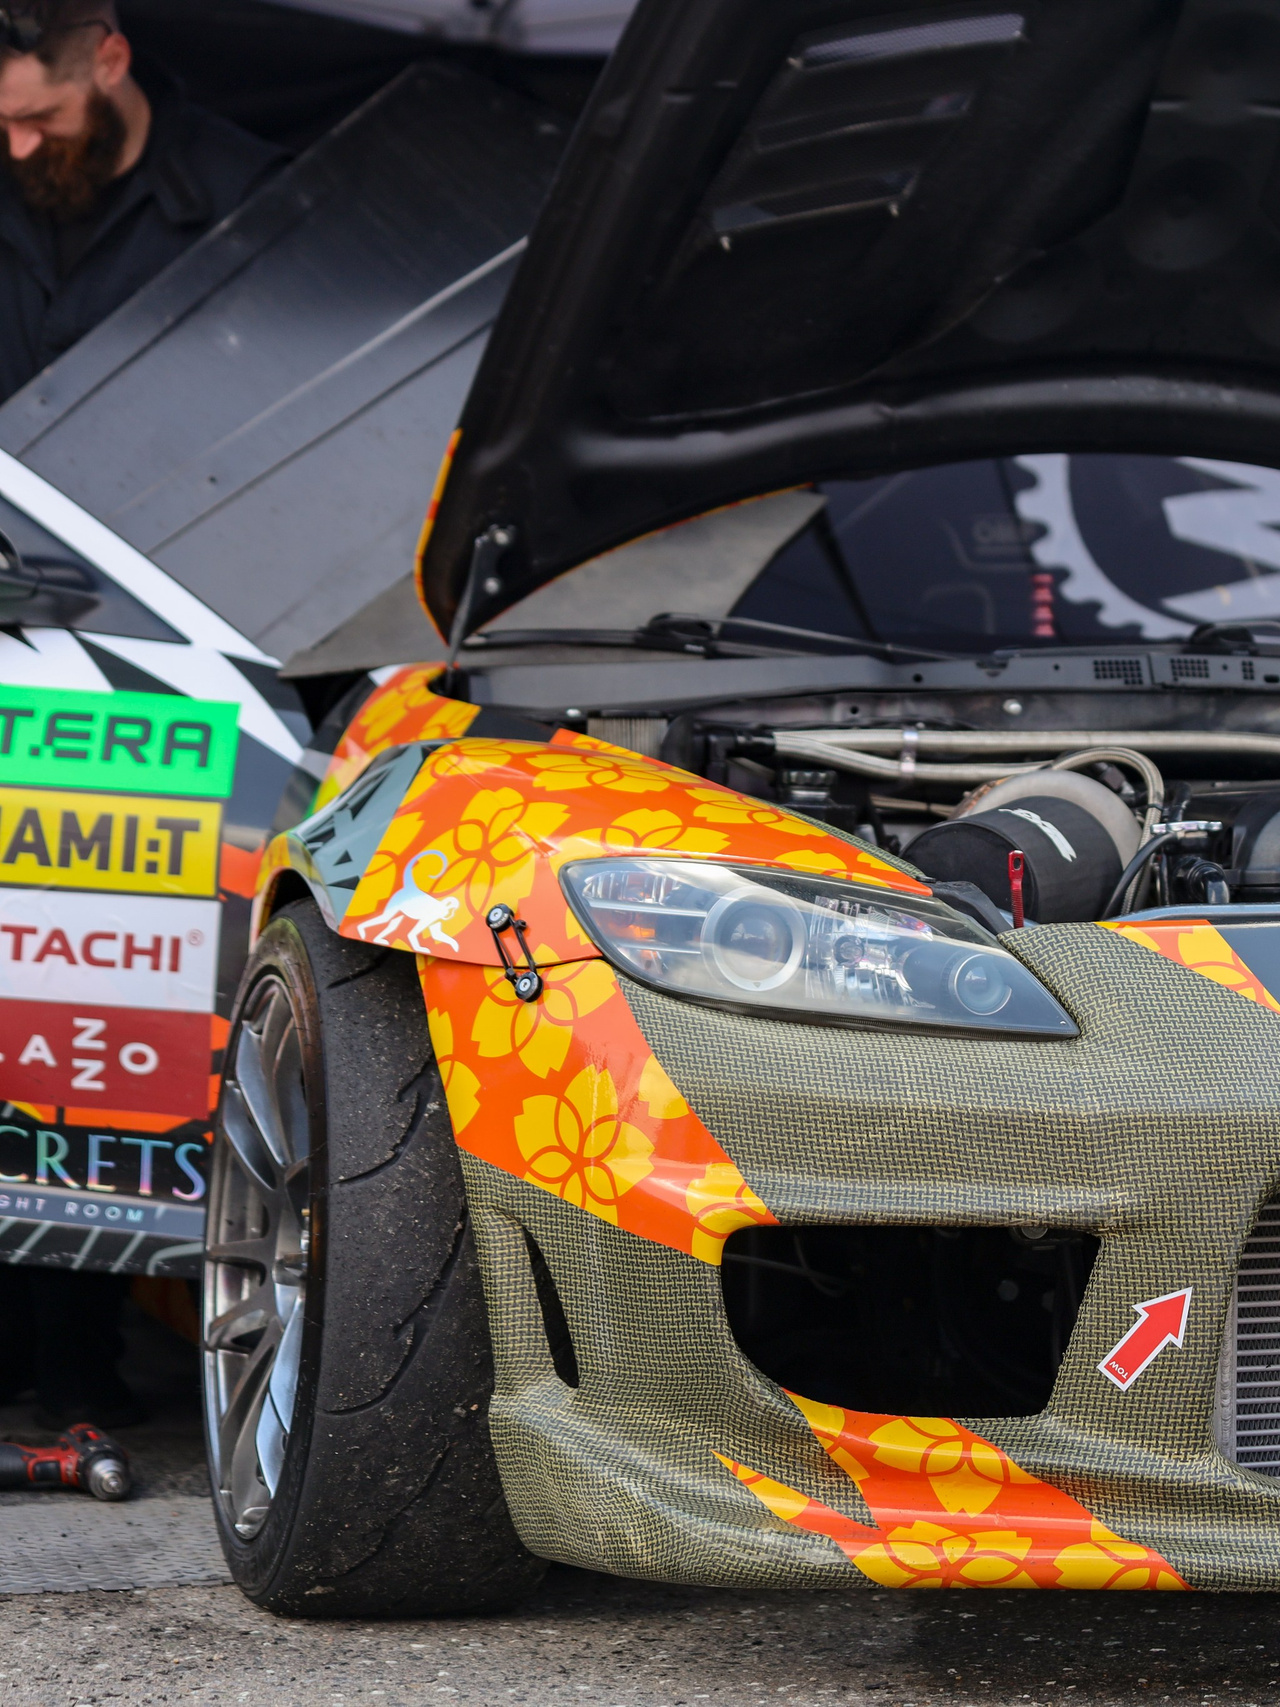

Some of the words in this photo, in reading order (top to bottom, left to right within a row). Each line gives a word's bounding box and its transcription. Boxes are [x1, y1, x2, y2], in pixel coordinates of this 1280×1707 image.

[0, 805, 200, 876] AMI:T
[64, 1200, 144, 1223] ROOM
[1109, 1360, 1129, 1380] TOW
